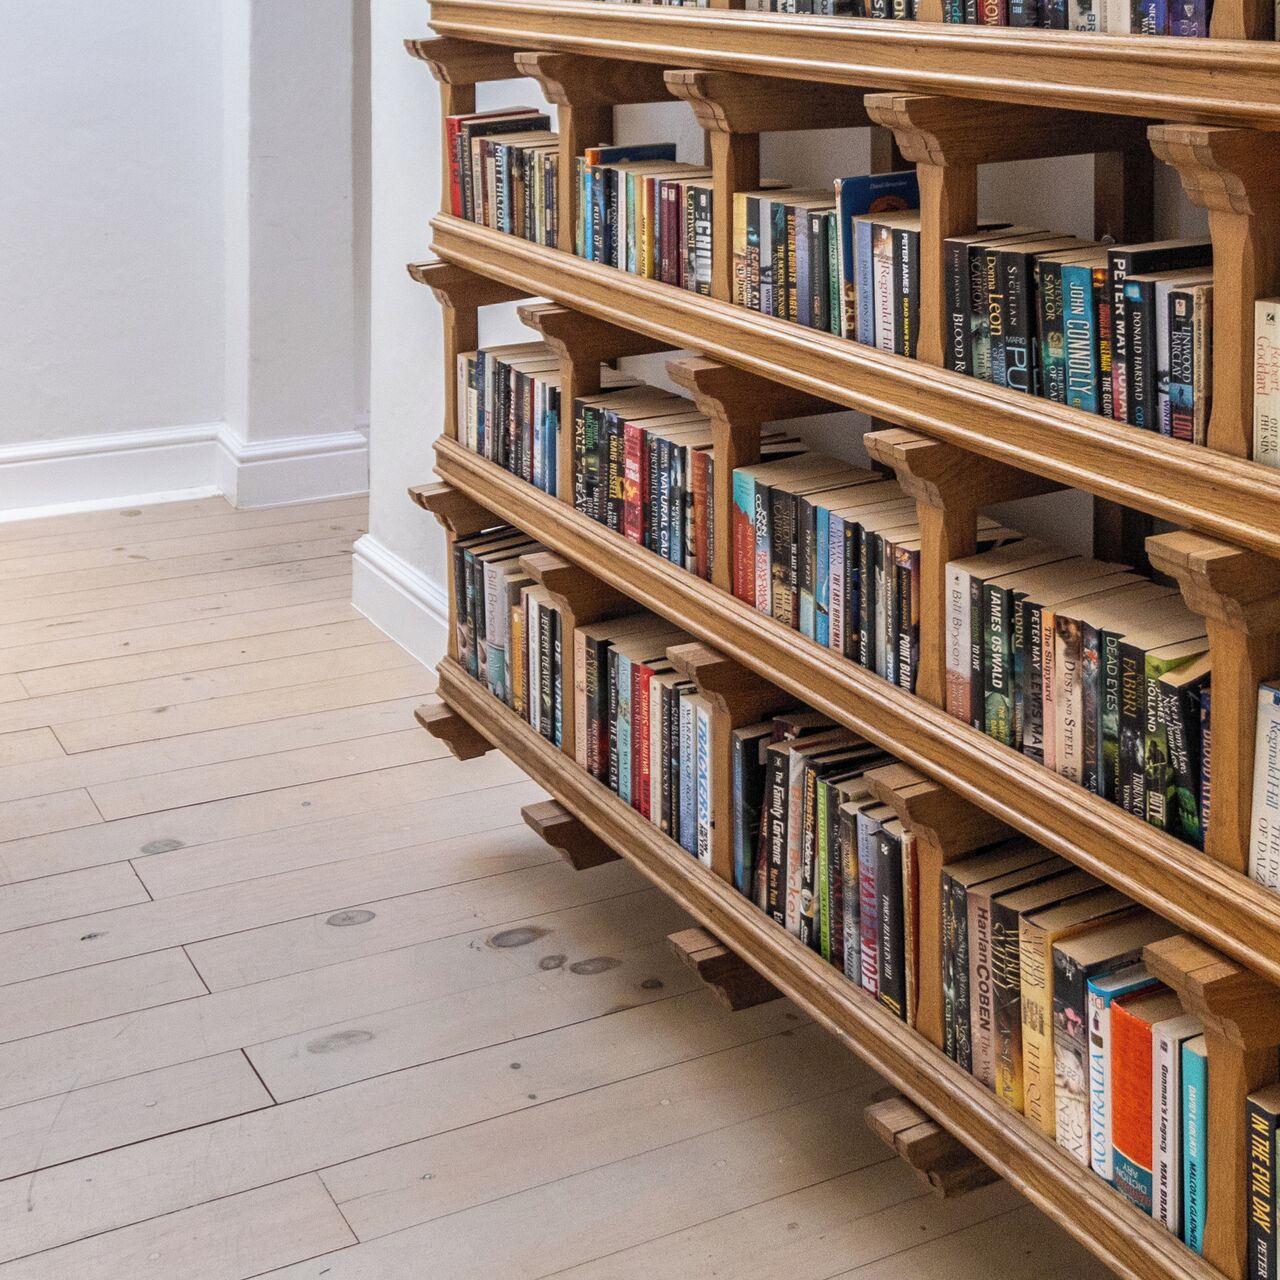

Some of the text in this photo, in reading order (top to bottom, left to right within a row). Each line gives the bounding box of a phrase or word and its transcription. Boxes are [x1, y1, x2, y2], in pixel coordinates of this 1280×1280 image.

[496, 181, 504, 232] HILTON
[989, 295, 1003, 336] Leon
[1114, 258, 1126, 354] PETER MAY
[1066, 282, 1092, 395] JOHN CONNOLLY
[1172, 331, 1182, 377] BARCLAY
[1181, 326, 1191, 383] LINWOOD
[609, 435, 618, 499] CRAIG RUSSELL
[660, 472, 668, 527] NATURAL
[990, 590, 1003, 689] JAMES OSWALD
[1031, 609, 1040, 669] PETER MAY
[1043, 649, 1052, 704] Shipyard
[1106, 637, 1119, 712] DEAD EYES
[1123, 656, 1135, 719] FABBRI
[1147, 679, 1156, 732] HOLLAND
[976, 965, 991, 1033] COBEN
[1091, 1052, 1106, 1178] AUSTRALIA
[1251, 1162, 1270, 1234] EVIL DAY
